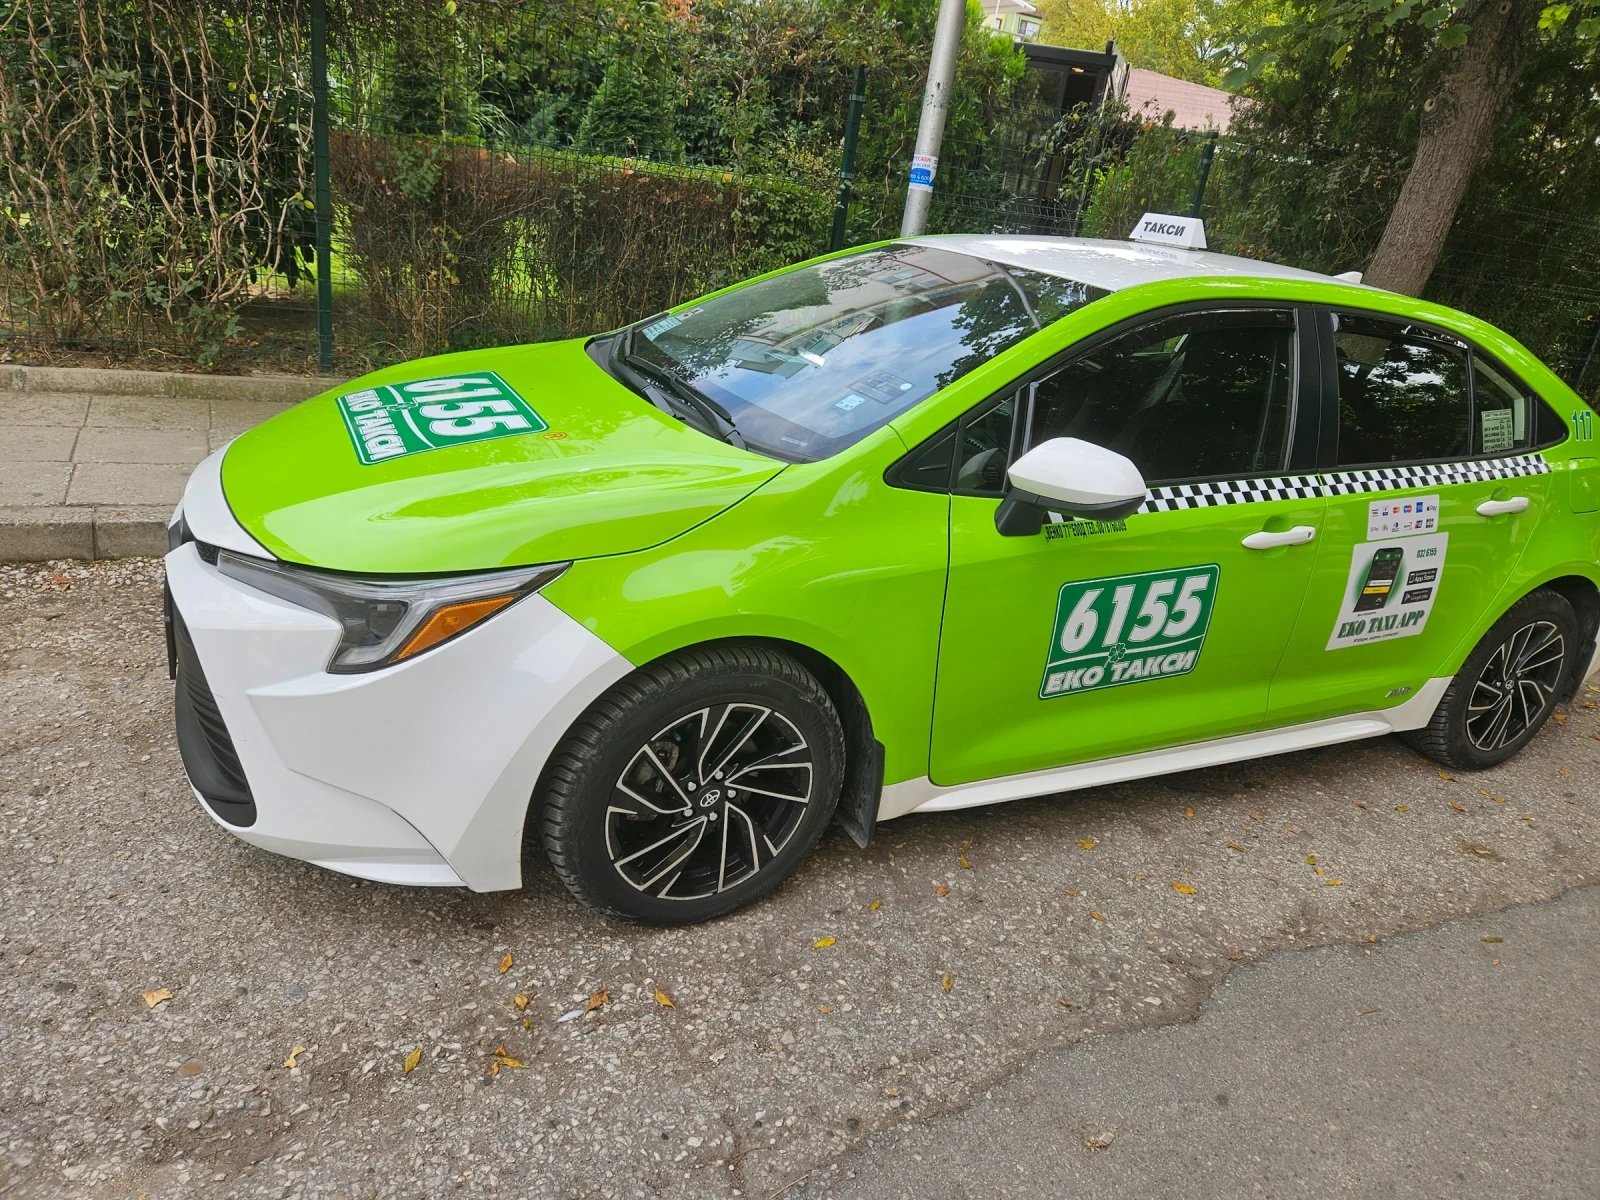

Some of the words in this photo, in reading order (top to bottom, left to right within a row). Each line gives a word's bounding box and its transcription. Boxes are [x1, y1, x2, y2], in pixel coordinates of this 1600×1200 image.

[1143, 221, 1186, 237] ТАКСИ
[344, 389, 383, 412] ЕКО
[404, 378, 532, 436] 6155
[353, 409, 408, 461] ТАКСИ
[1572, 410, 1593, 441] 117
[1060, 574, 1211, 654] 6155
[1337, 619, 1366, 639] EKO
[1367, 613, 1399, 633] TAXI
[1395, 609, 1425, 629] APP
[1044, 666, 1105, 695] ЕКО
[1111, 649, 1198, 683] ТАКСИ
